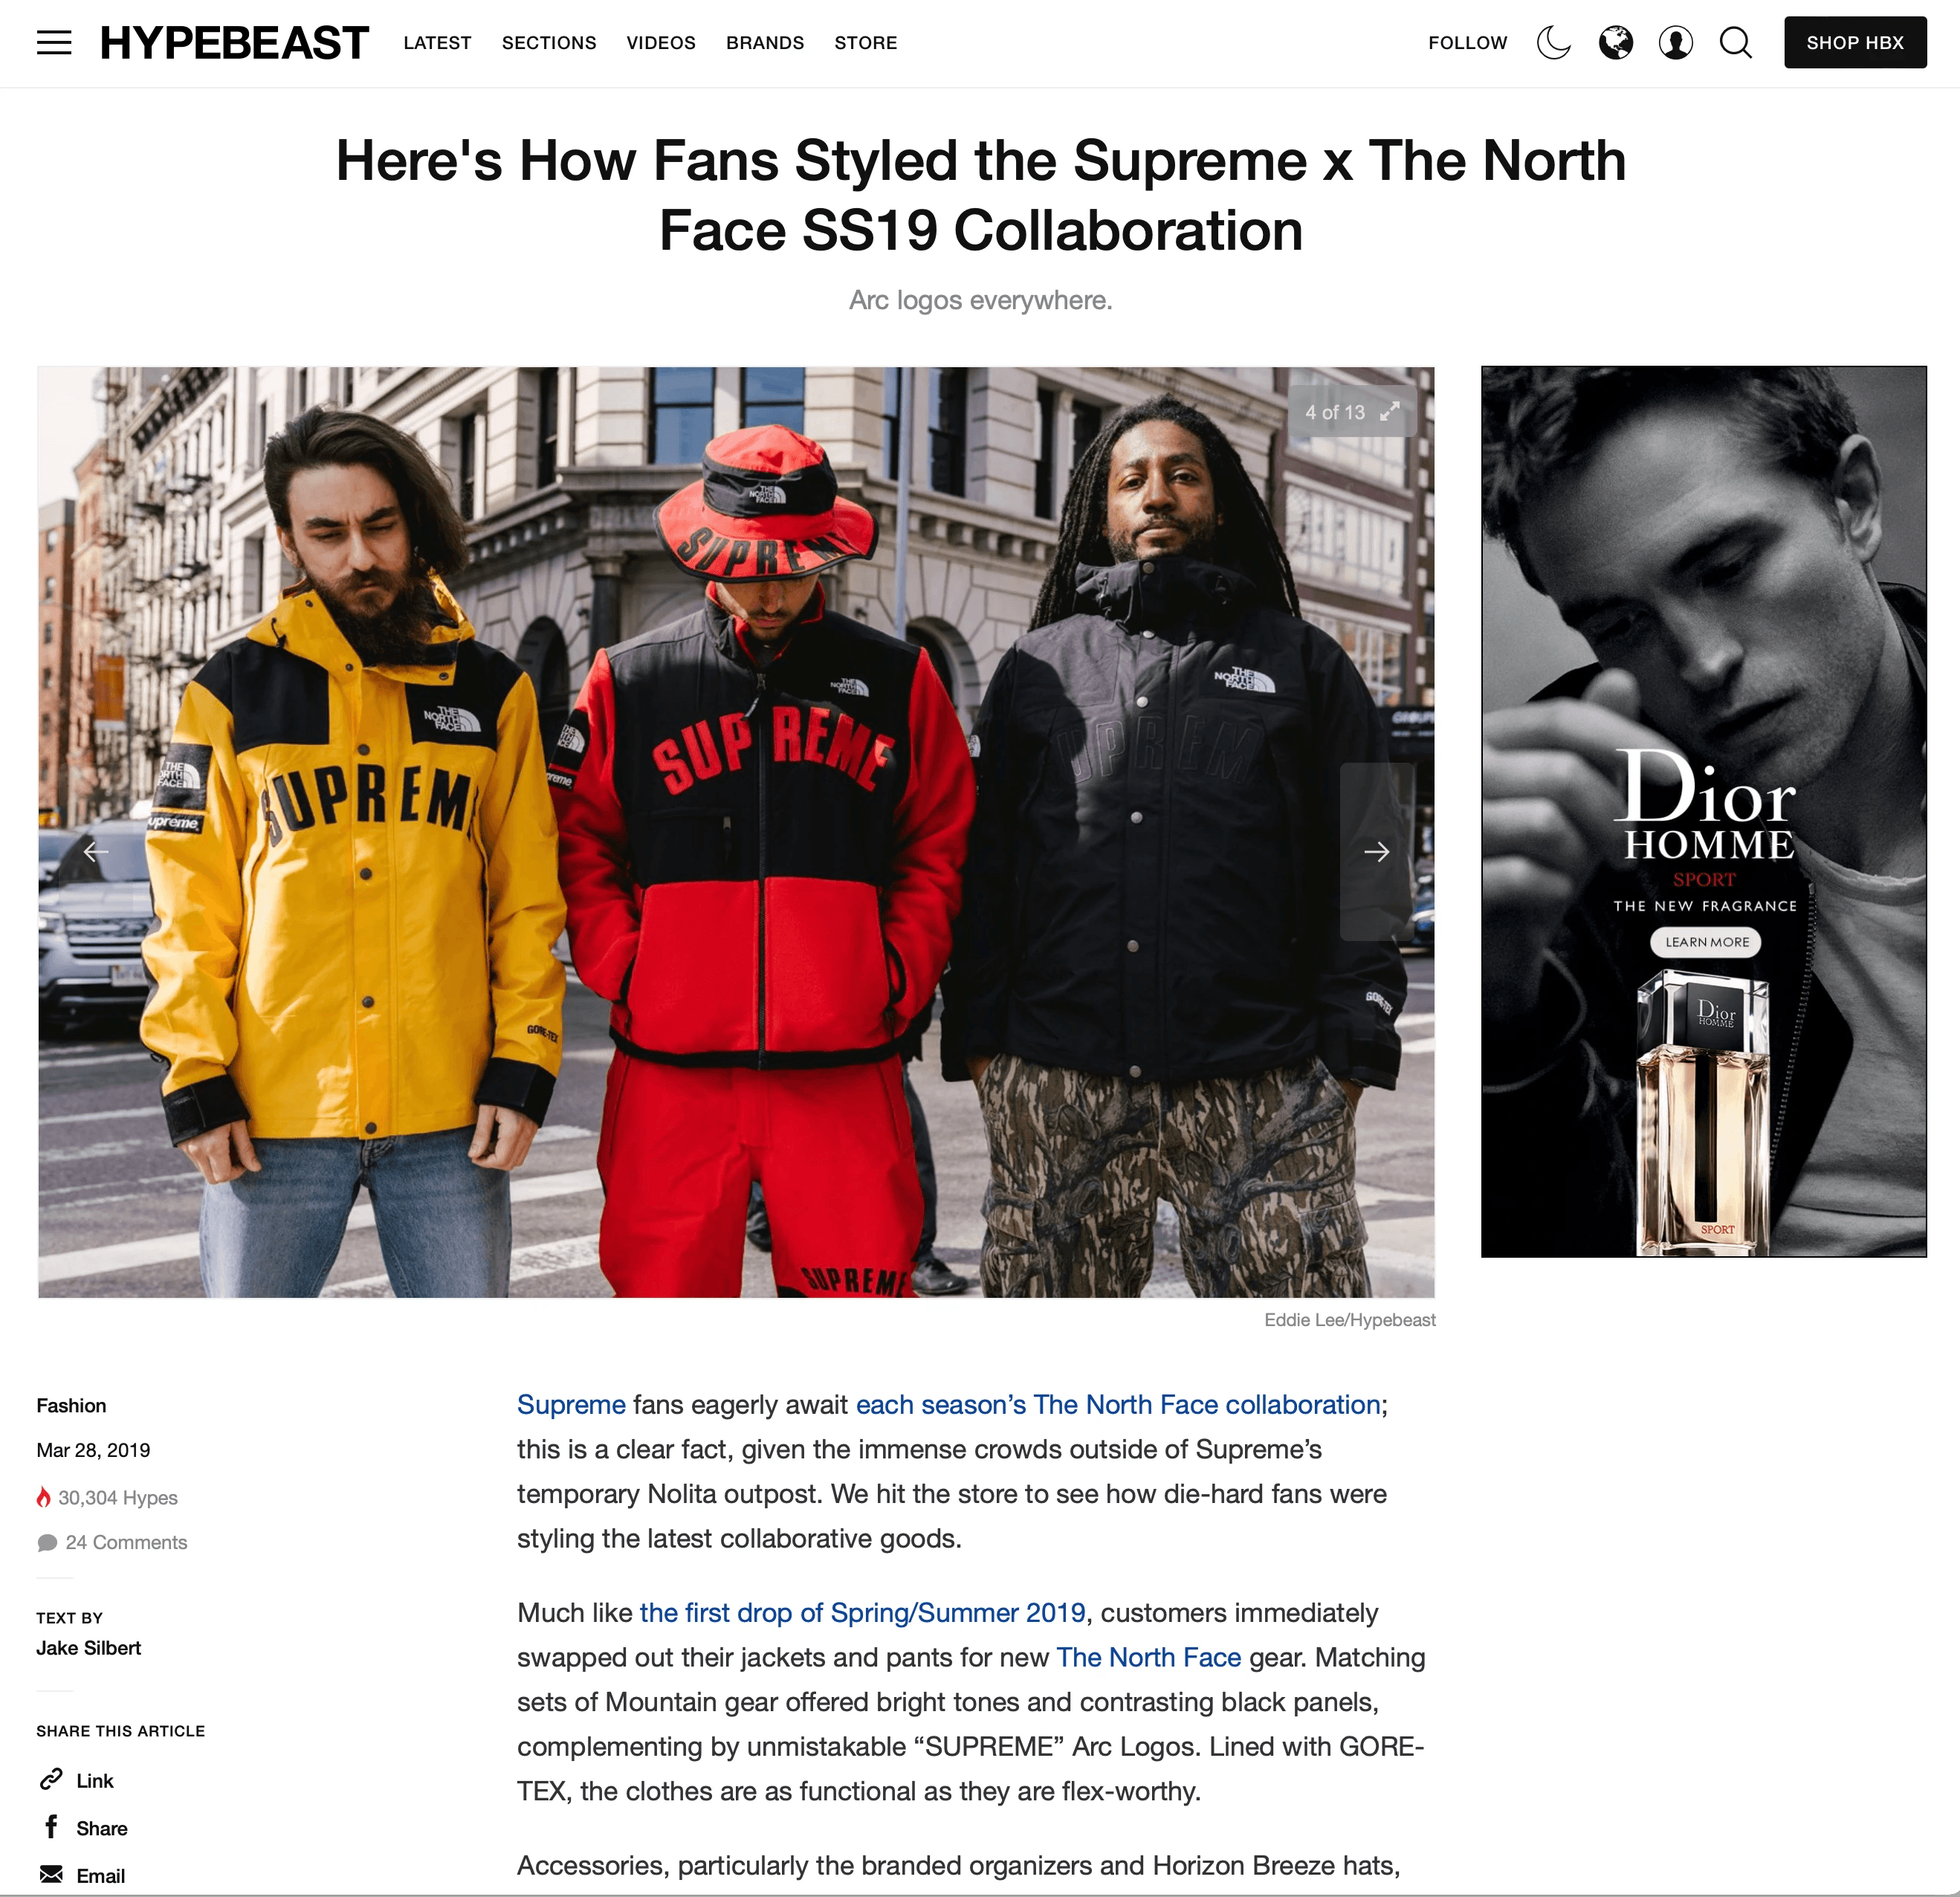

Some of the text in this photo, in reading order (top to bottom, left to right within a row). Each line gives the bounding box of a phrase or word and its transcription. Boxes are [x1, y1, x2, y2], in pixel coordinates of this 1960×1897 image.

[102, 25, 369, 59] HYPEBEAST
[405, 36, 471, 50] LATEST
[502, 36, 596, 50] SECTIONS
[627, 36, 695, 50] VIDEOS
[728, 36, 803, 50] BRANDS
[835, 36, 897, 50] STORE
[1430, 36, 1507, 50] FOLLOW
[1808, 36, 1904, 50] SHOP HBX
[339, 138, 1625, 192] Here's How Fans Styled the Supreme x The North
[662, 208, 1301, 251] Face SS19 Collaboration
[850, 290, 1111, 315] Arc logos everywhere.
[677, 526, 853, 576] SUPREM
[1215, 671, 1254, 684] NORTH
[1232, 666, 1254, 676] THE
[1226, 680, 1254, 691] FACE
[424, 710, 459, 724] NORTH
[437, 705, 459, 716] THE
[435, 721, 461, 731] FACE
[166, 761, 184, 771] THE
[159, 770, 183, 780] ORTH
[157, 778, 184, 788] FACE
[1613, 748, 1796, 822] Dior
[261, 763, 476, 847] SUPREM
[147, 816, 198, 830] upreme
[1624, 830, 1795, 859] HOMME
[1673, 872, 1736, 887] SPORT
[1614, 901, 1796, 911] THE NEW FRAGRANCE
[1667, 937, 1749, 947] LEARN MORE
[1697, 998, 1736, 1021] Dior
[1699, 1017, 1734, 1028] HOMME
[1701, 1224, 1736, 1235] SPORT
[1266, 1313, 1436, 1330] Eddie Lee/Hypebeast
[38, 1398, 106, 1413] Fashion
[518, 1394, 1386, 1420] Supreme fans eagerly await each season’s The North Face collaboration;
[38, 1443, 150, 1460] Mar 28, 2019
[517, 1438, 1322, 1464] this is a clear fact, given the immense crowds outside of Supreme’s
[59, 1490, 178, 1508] 30,304 Hypes
[66, 1535, 187, 1549] 24 Comments
[518, 1528, 960, 1554] styling the latest collaborative goods.
[36, 1612, 103, 1623] TEXT BY
[519, 1602, 1379, 1628] Much like the first drop of Spring/Summer 2019, customers immediately
[36, 1640, 141, 1655] Jake Silbert
[36, 1725, 204, 1737] SHARE THIS ARTICLE
[518, 1736, 1424, 1762] complementing by unmistakable “SUPREME” Arc Logos. Lined with GORE-
[78, 1774, 114, 1788] Link
[517, 1780, 1200, 1806] TEX, the clothes are as functional as they are flex-worthy.
[77, 1820, 128, 1836] Share
[517, 1855, 1399, 1881] Accessories, particularly the branded organizers and Horizon Breeze hats,
[78, 1869, 125, 1884] Email
